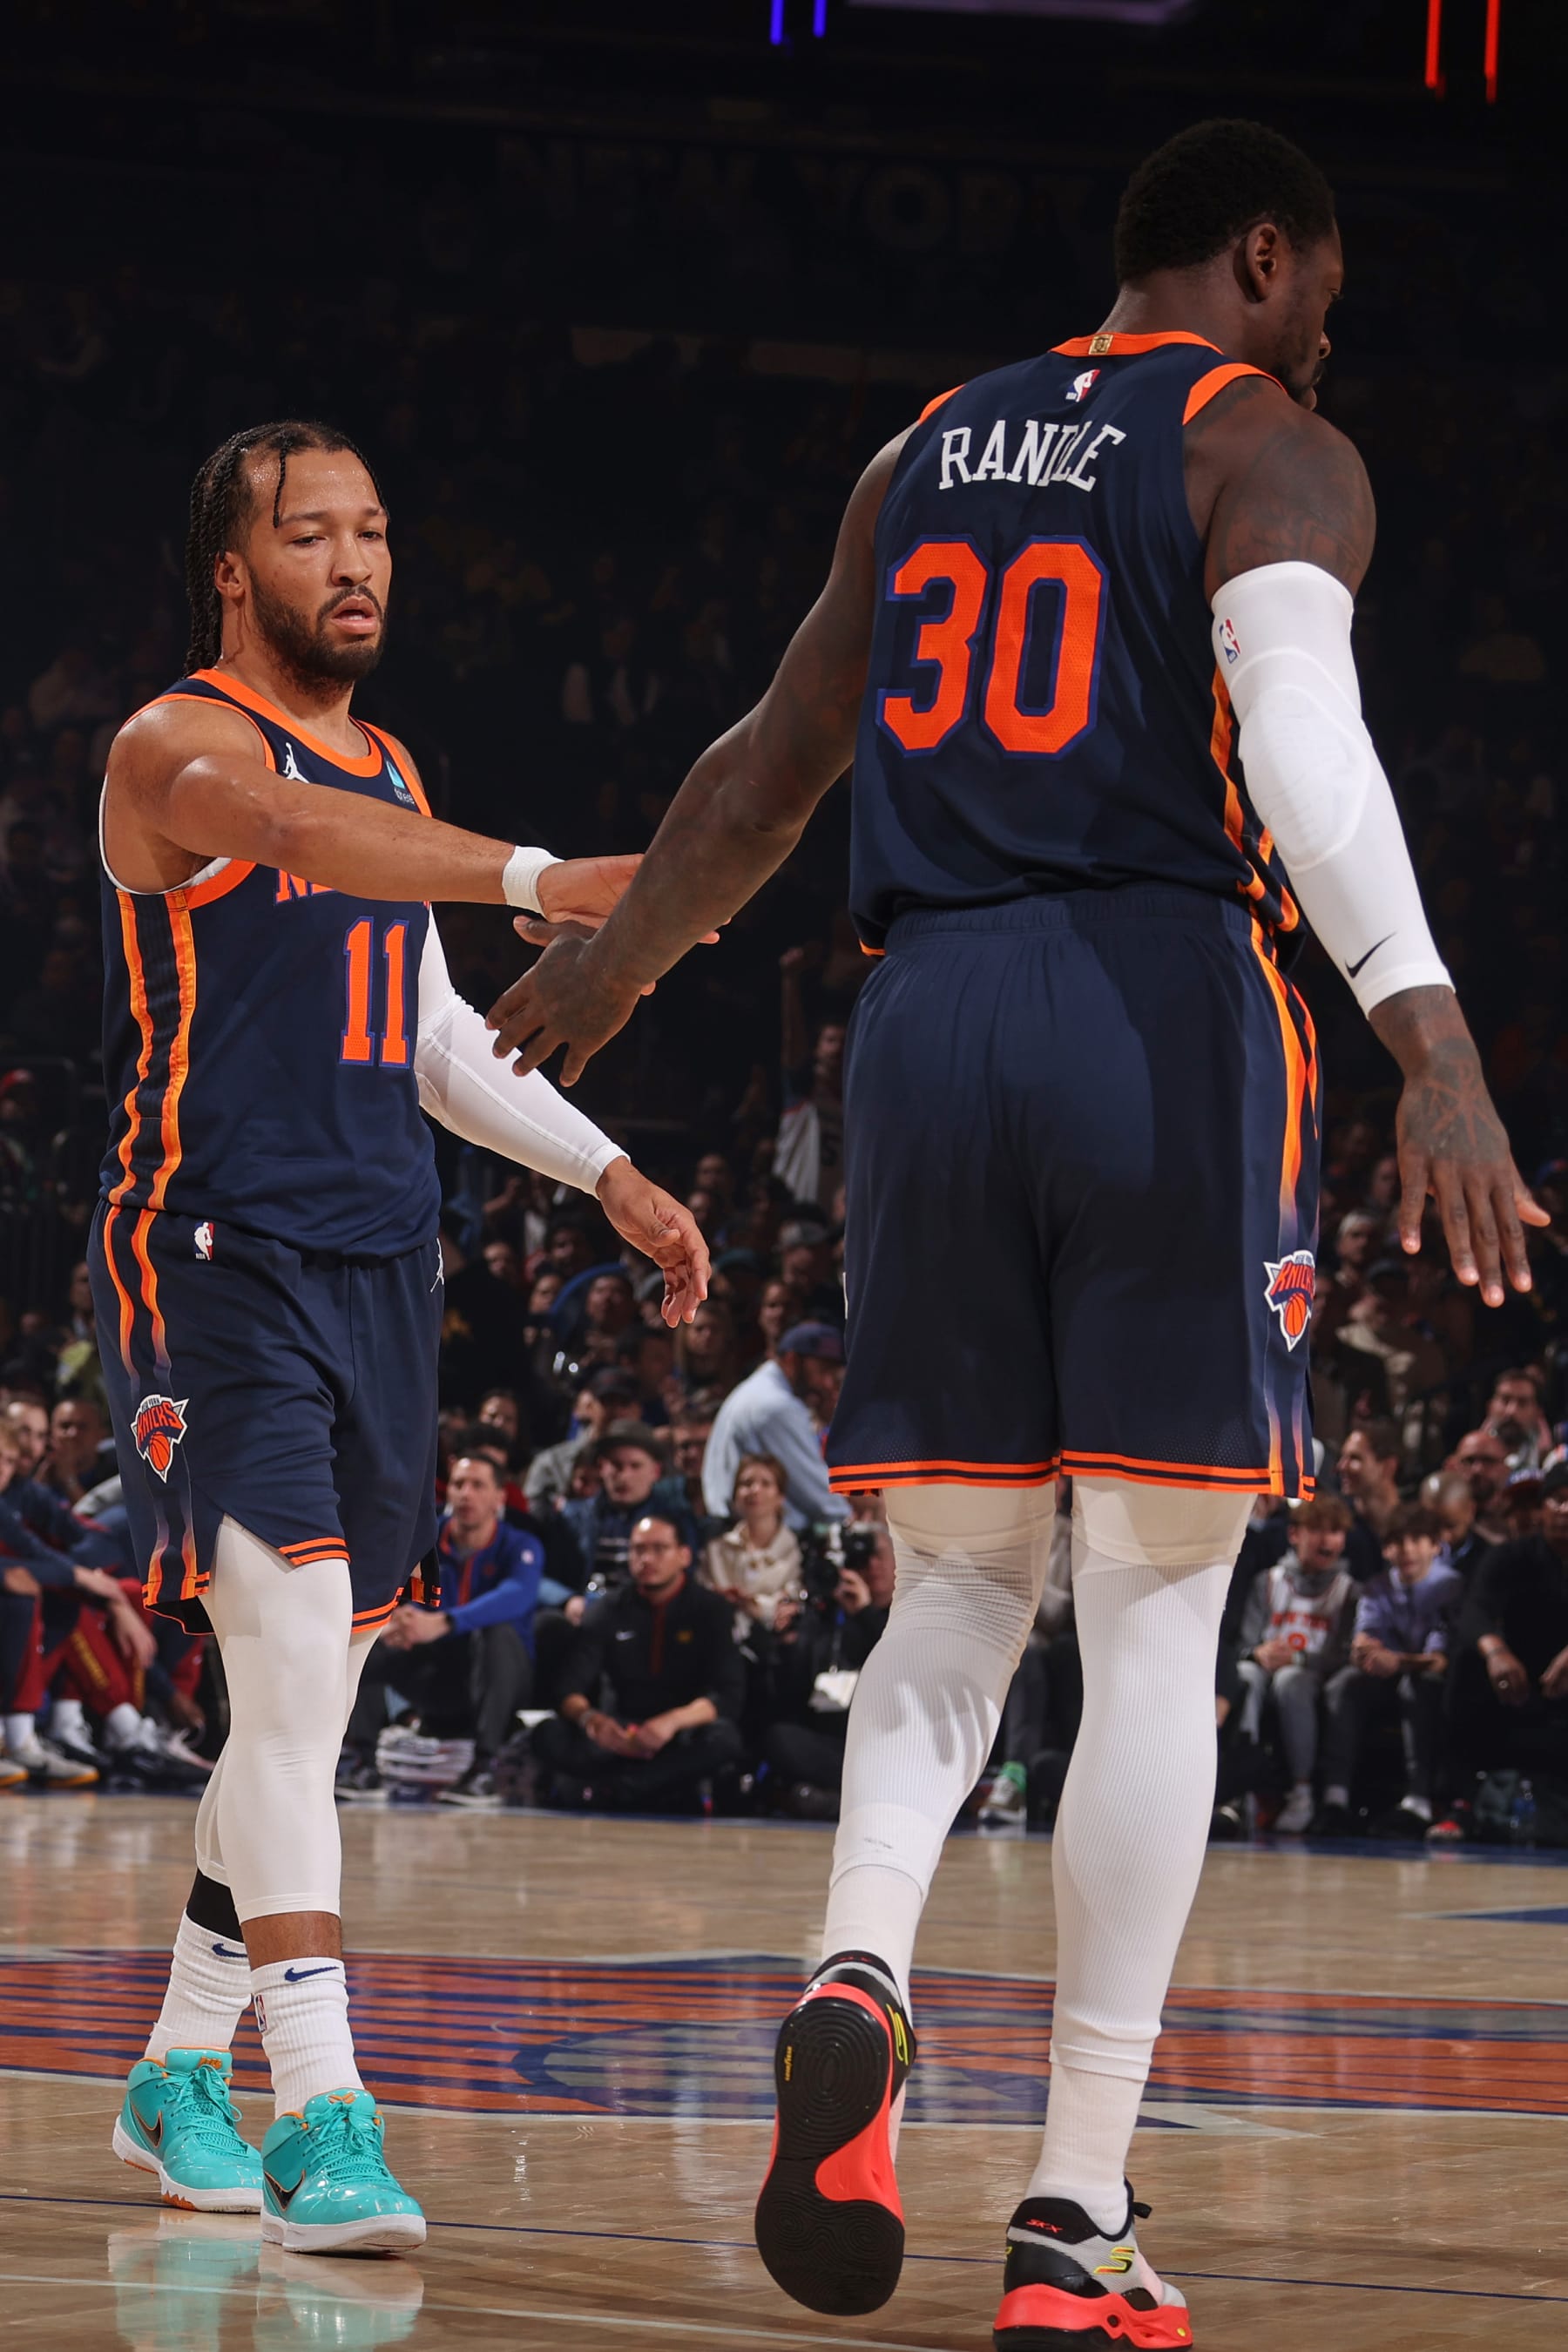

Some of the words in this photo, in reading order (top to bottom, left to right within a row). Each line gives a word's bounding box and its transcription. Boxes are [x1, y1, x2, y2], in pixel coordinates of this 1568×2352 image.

[876, 534, 1109, 760] 30
[340, 916, 409, 1069] 11
[137, 1401, 183, 1448] KNICKS
